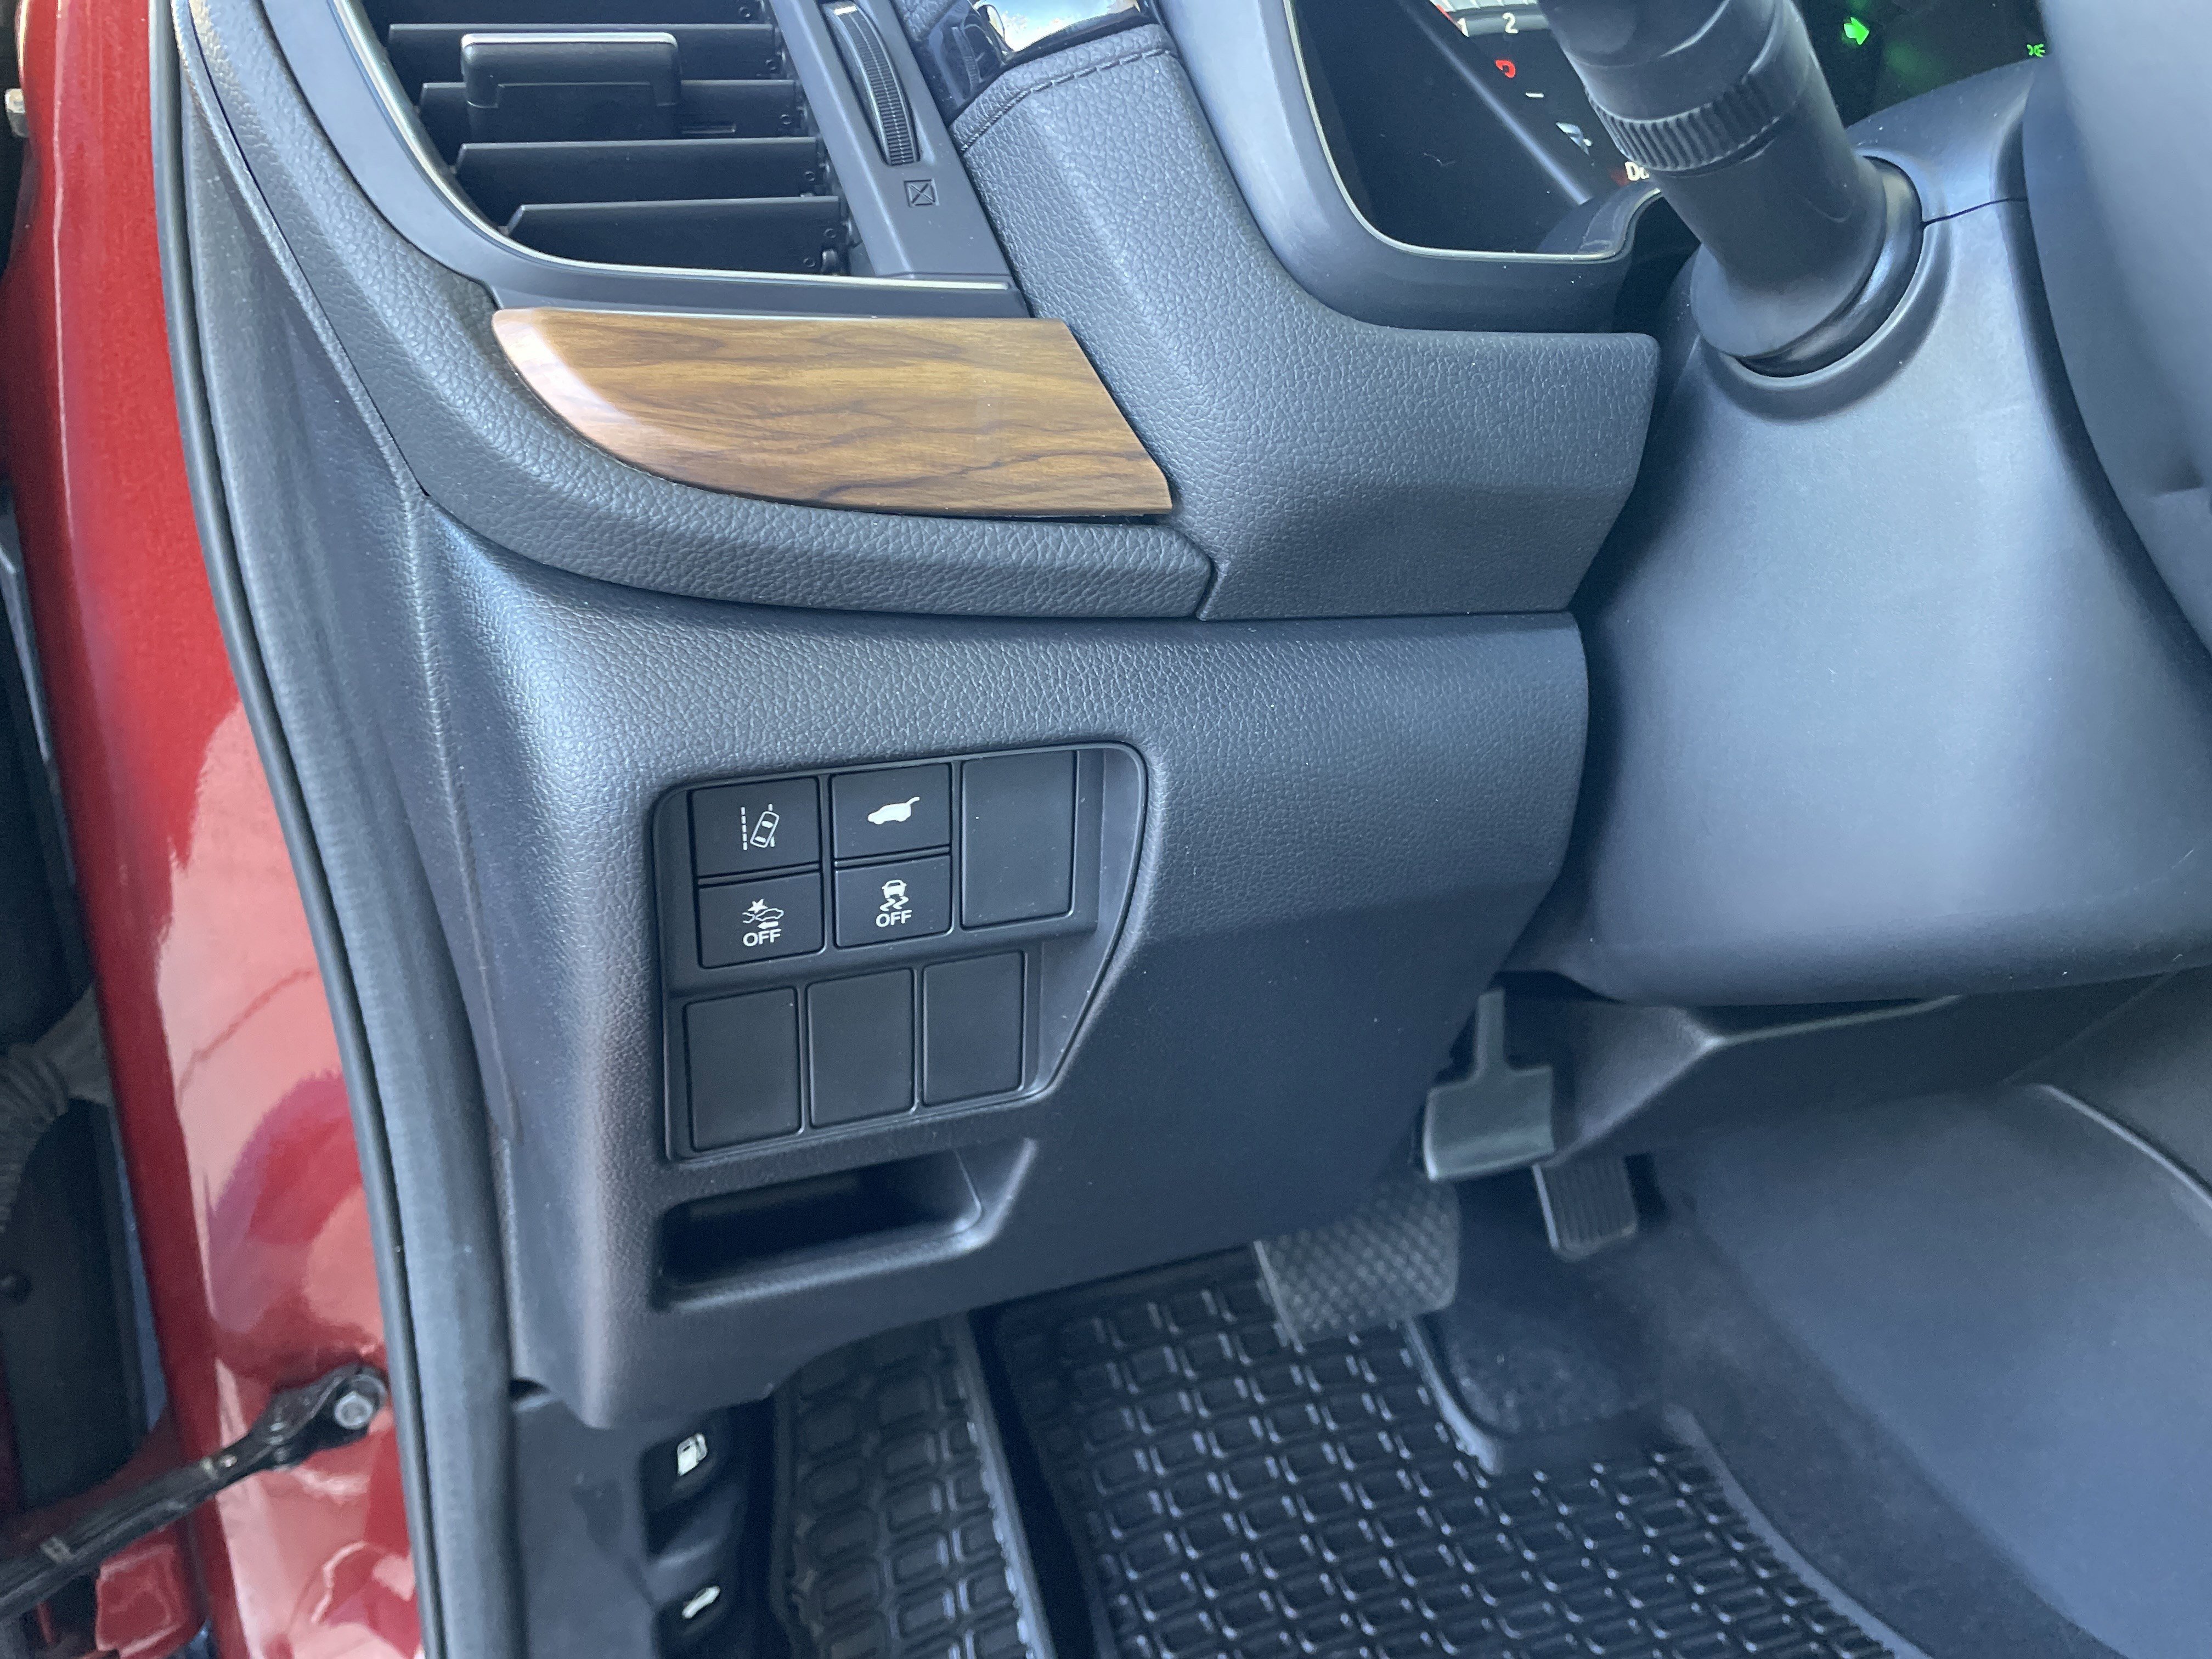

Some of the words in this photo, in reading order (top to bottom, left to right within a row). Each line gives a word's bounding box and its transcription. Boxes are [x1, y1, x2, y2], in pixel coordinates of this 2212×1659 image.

[1502, 12, 1519, 33] 2
[876, 910, 912, 927] OFF
[743, 928, 782, 947] OFF
